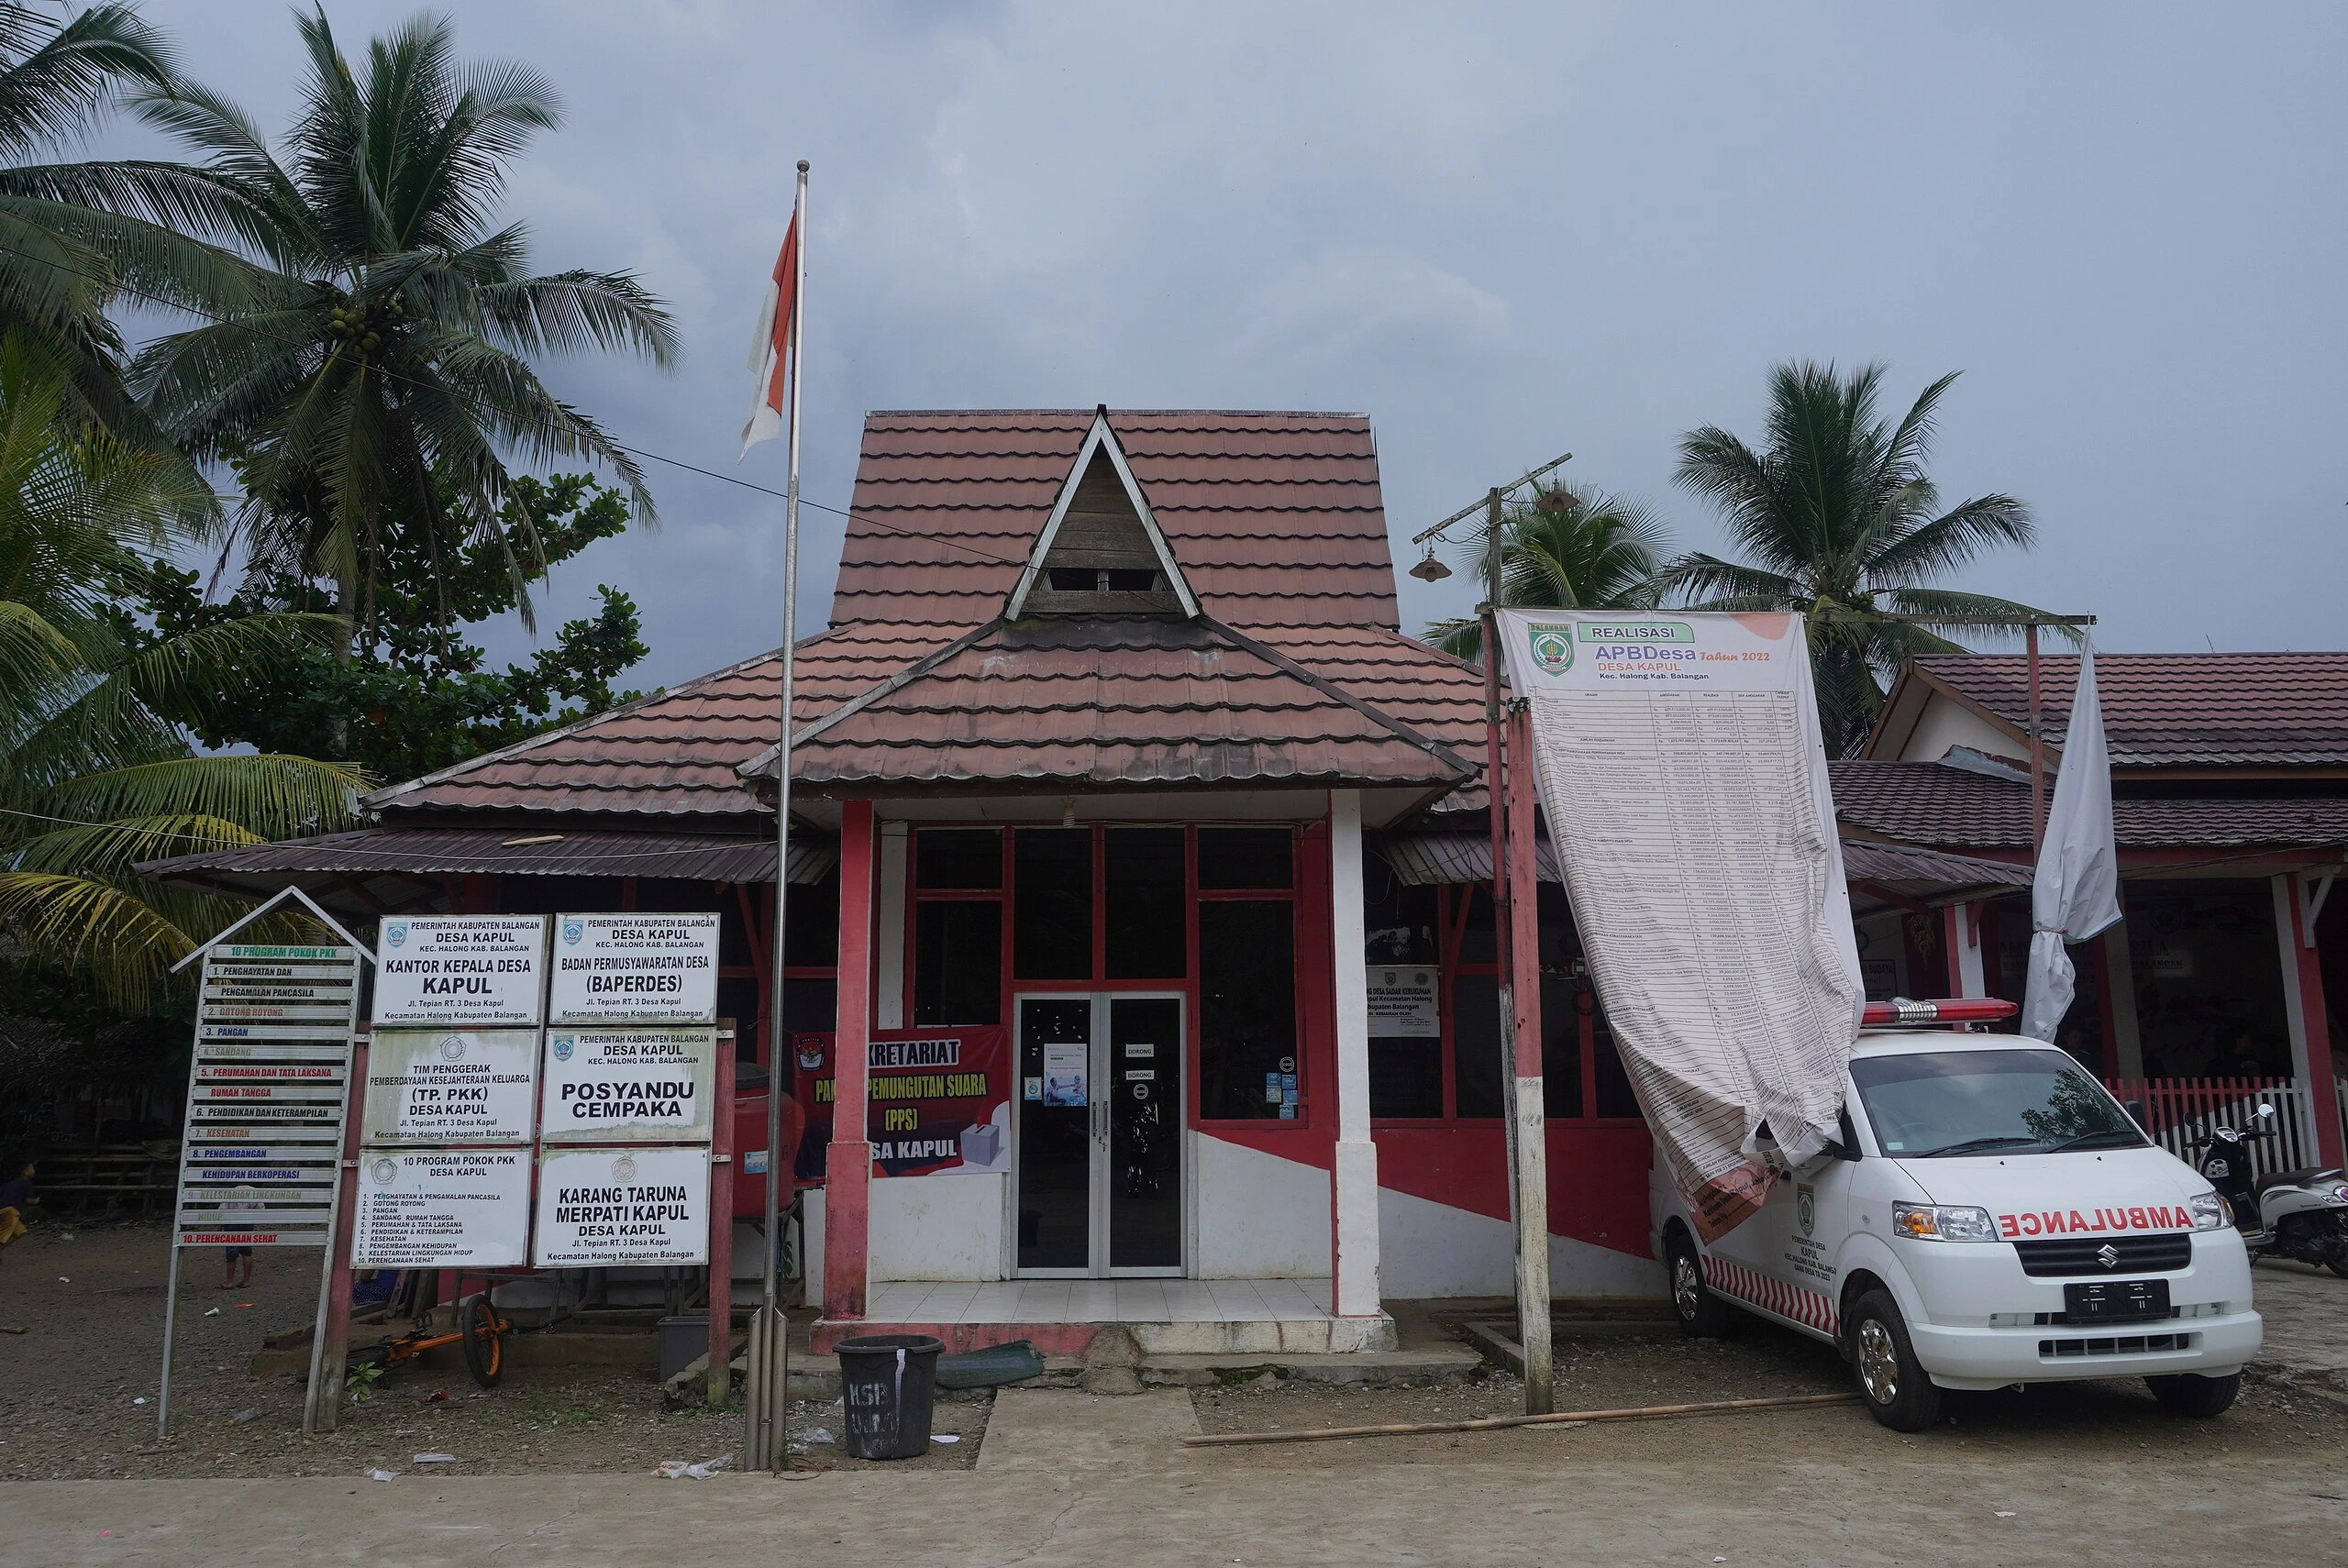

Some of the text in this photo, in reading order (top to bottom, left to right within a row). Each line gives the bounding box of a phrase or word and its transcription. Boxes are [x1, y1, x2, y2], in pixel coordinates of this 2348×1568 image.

[1592, 627, 1675, 639] REALISASI
[1595, 645, 1770, 661] APBDesa Tahun 2022
[1598, 662, 1680, 671] DESA KAPUL
[588, 920, 632, 928] PEMERINTAH
[436, 933, 515, 943] DESA KAPUL
[612, 930, 690, 939] DESA KAPUL
[231, 947, 338, 958] 10 PROGRAM POKOK PKK
[386, 960, 530, 973] KANTOR KEPALA DESA
[562, 956, 708, 970] BADAN PERMUSYAWARATAN DESA
[214, 966, 292, 977] 1. PENGHAYATAN DAN
[423, 977, 492, 994] KAPUL
[587, 975, 681, 993] (BAPERDES)
[221, 988, 314, 998] PENGAMALAN PANCASILA
[208, 1008, 283, 1017] 2. GOTONG ROYONG
[206, 1028, 248, 1037] 3. PANGAN
[216, 1047, 250, 1056] SANDANG
[604, 1045, 682, 1055] DESA KAPUL
[869, 1042, 959, 1066] KRETARIAT
[213, 1068, 260, 1077] PERUMAHAN
[261, 1069, 276, 1077] DAN
[278, 1068, 296, 1077] TATA
[297, 1068, 331, 1077] LAKSANA
[414, 1065, 491, 1074] TIM PENGGERAK
[370, 1075, 530, 1086] PEMBERDAYAAN KESEJAHTERAAN KELUARGA
[947, 1074, 986, 1097] SUARA
[211, 1088, 271, 1098] RUMAH TANGGA
[412, 1087, 488, 1102] (TP. PKK)
[561, 1082, 694, 1099] POSYANDU
[196, 1109, 327, 1118] 6. PENDIDIKAN DAN KETERAMPILAN
[410, 1105, 487, 1115] DESA KAPUL
[572, 1101, 681, 1118] CEMPAKA
[885, 1109, 917, 1131] (PPS)
[195, 1129, 249, 1138] 7. KESEHATAN
[194, 1150, 266, 1159] 8. PENGEMBANGAN
[871, 1140, 957, 1159] SA KAPUL
[404, 1156, 515, 1165] 10 PROGRAM POKOK PKK
[203, 1170, 299, 1179] KEHIDUPAN BERKOPERASI
[201, 1191, 250, 1199] KELESTARIAN
[252, 1191, 301, 1199] LINGKUNGAN
[559, 1187, 686, 1204] KARANG TARUNA
[557, 1205, 689, 1222] MERPATI KAPUL
[579, 1224, 665, 1236] DESA KAPUL
[183, 1234, 277, 1243] 10. PERENCANAAN SEHAT
[1791, 1235, 1826, 1251] PEMERINTAH DESA
[1800, 1246, 1818, 1260] KAPUL
[1804, 1266, 1815, 1276] DESA
[1814, 1269, 1822, 1278] TA
